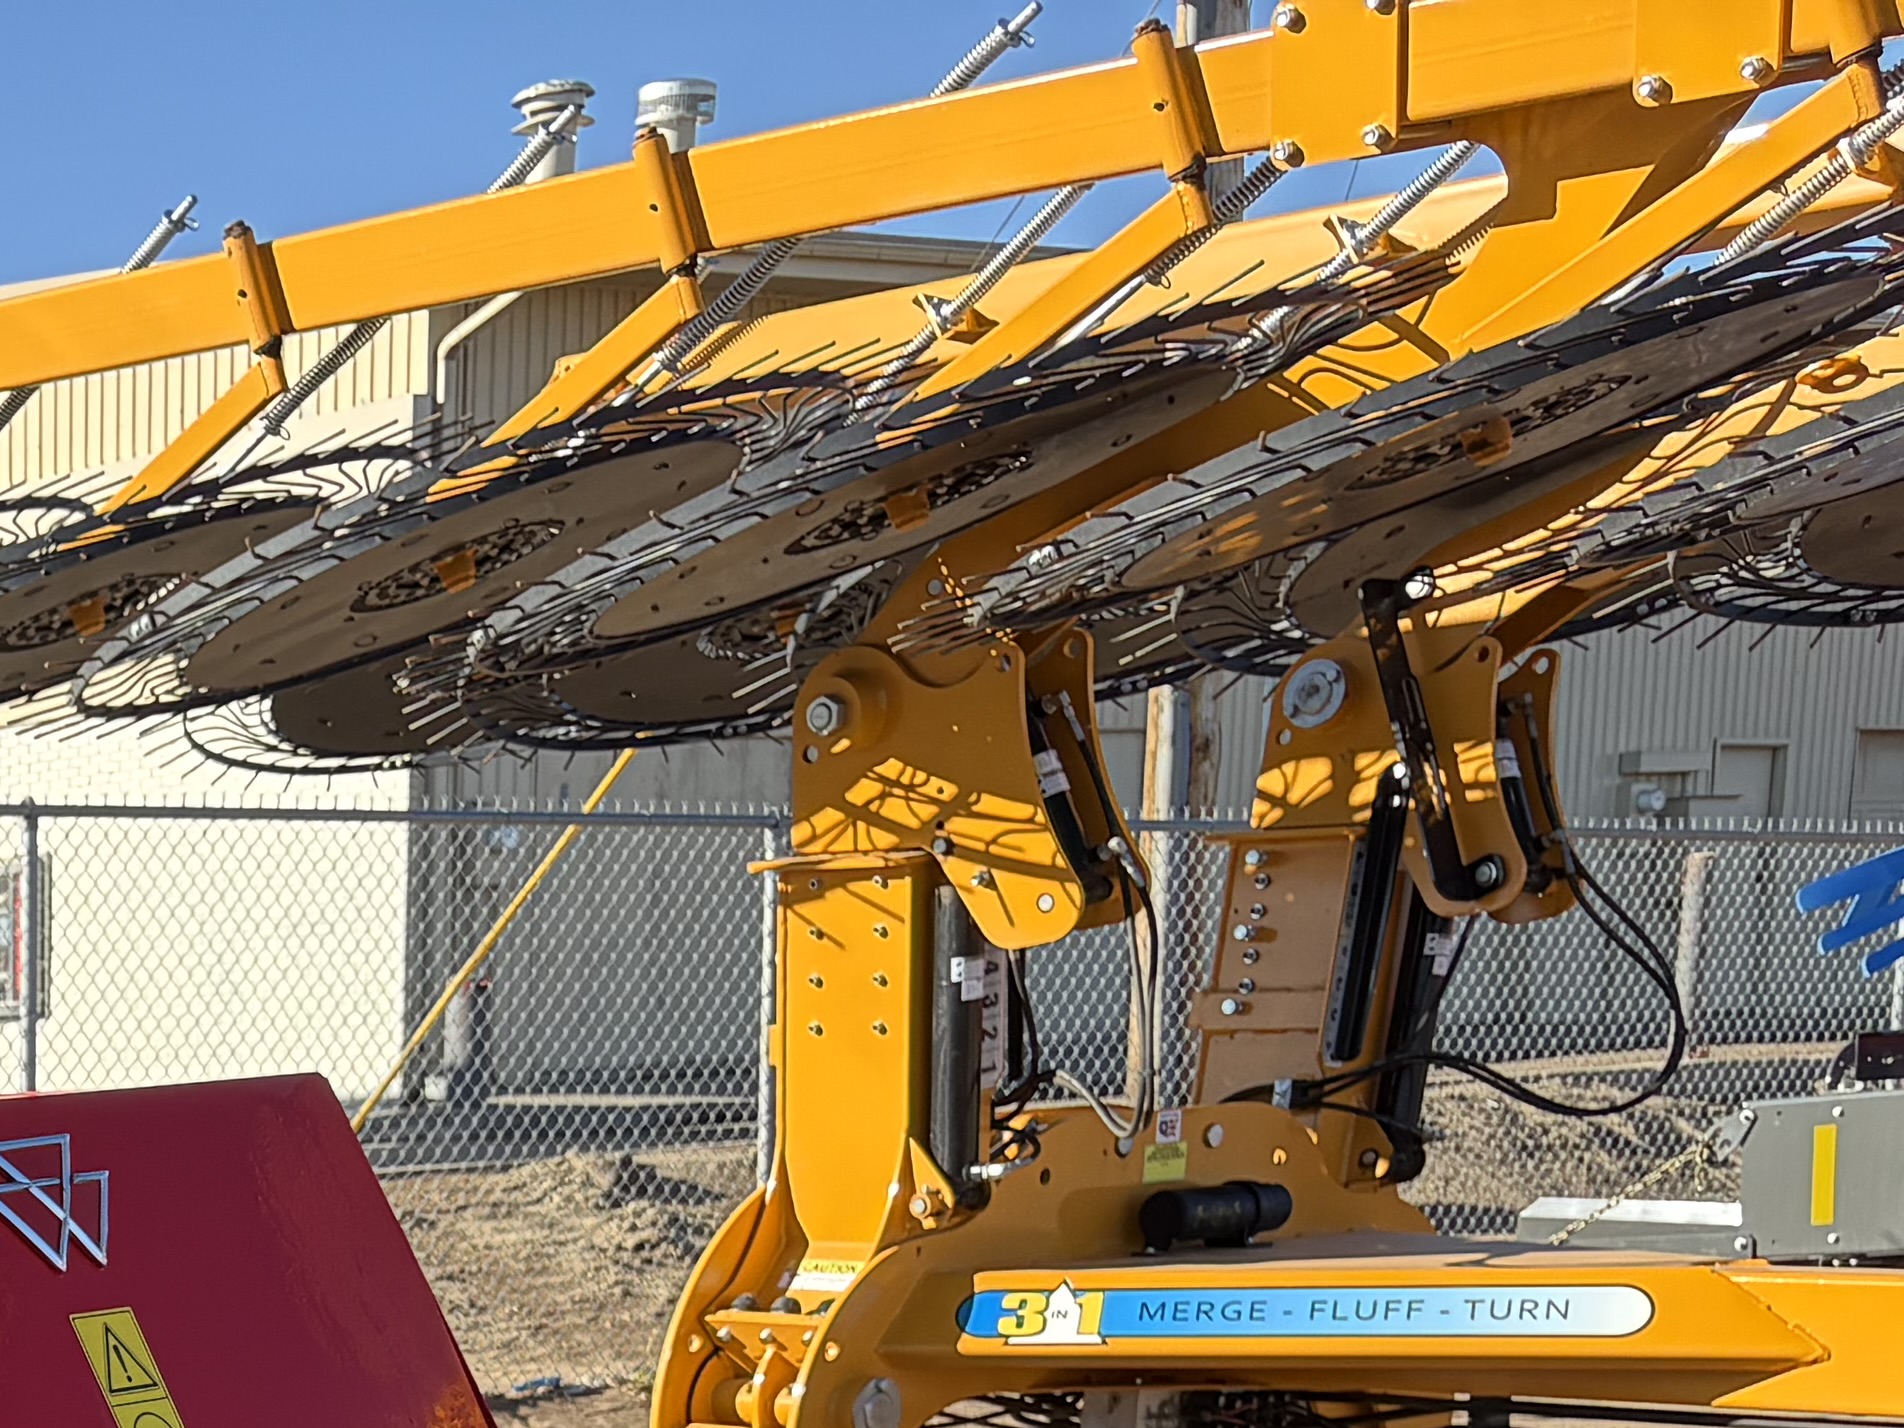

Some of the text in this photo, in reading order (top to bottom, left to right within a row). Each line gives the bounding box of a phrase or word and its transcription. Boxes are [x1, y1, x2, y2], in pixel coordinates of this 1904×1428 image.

[997, 1291, 1104, 1336] 3 IN 1
[1138, 1301, 1267, 1321] MERGE
[1309, 1299, 1425, 1321] FLUFF
[1464, 1299, 1571, 1321] TURN
